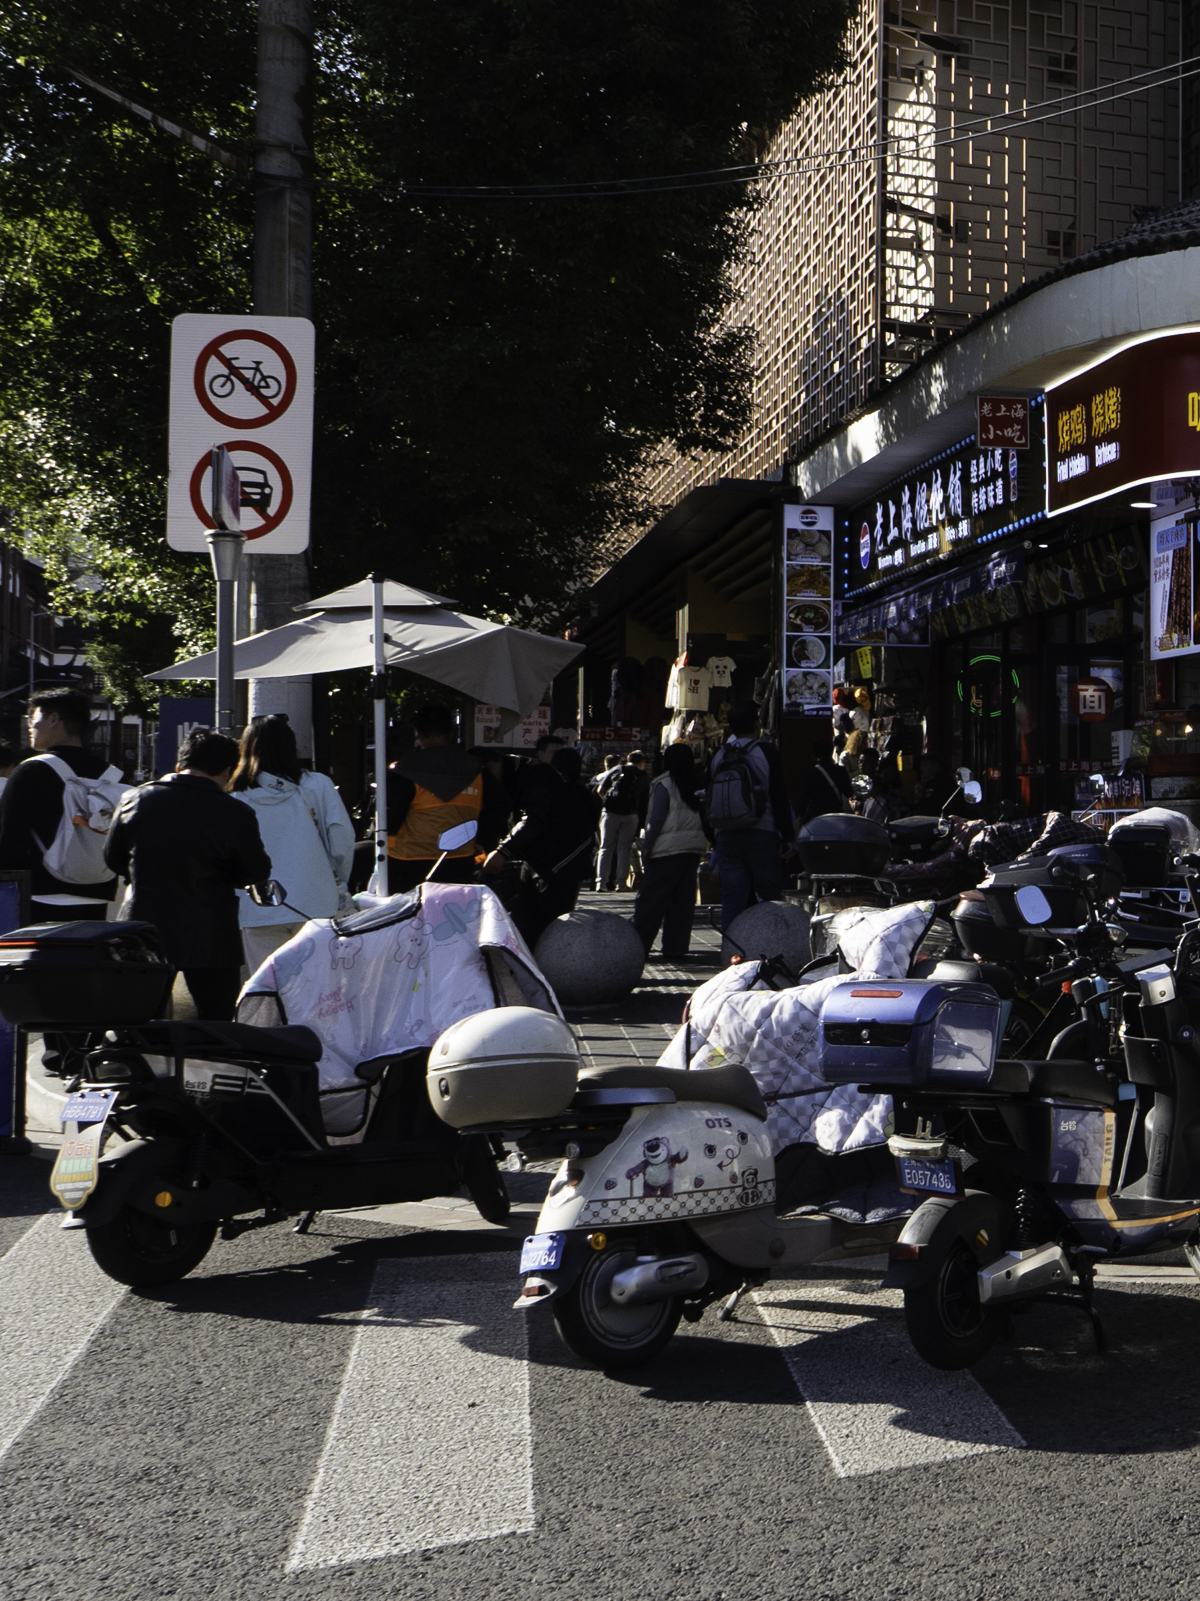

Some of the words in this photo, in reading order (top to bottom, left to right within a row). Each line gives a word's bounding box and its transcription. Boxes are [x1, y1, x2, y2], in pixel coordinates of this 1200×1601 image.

[980, 402, 1027, 419] 老上海
[1058, 404, 1084, 453] 炸鸡
[1091, 387, 1119, 437] 烧烤
[982, 423, 1026, 443] 小吃
[874, 460, 965, 554] 老上海馄饨铺
[971, 478, 1004, 516] 传统味道
[1078, 685, 1107, 714] 面
[705, 1117, 732, 1129] OTS
[904, 1169, 951, 1189] E057435
